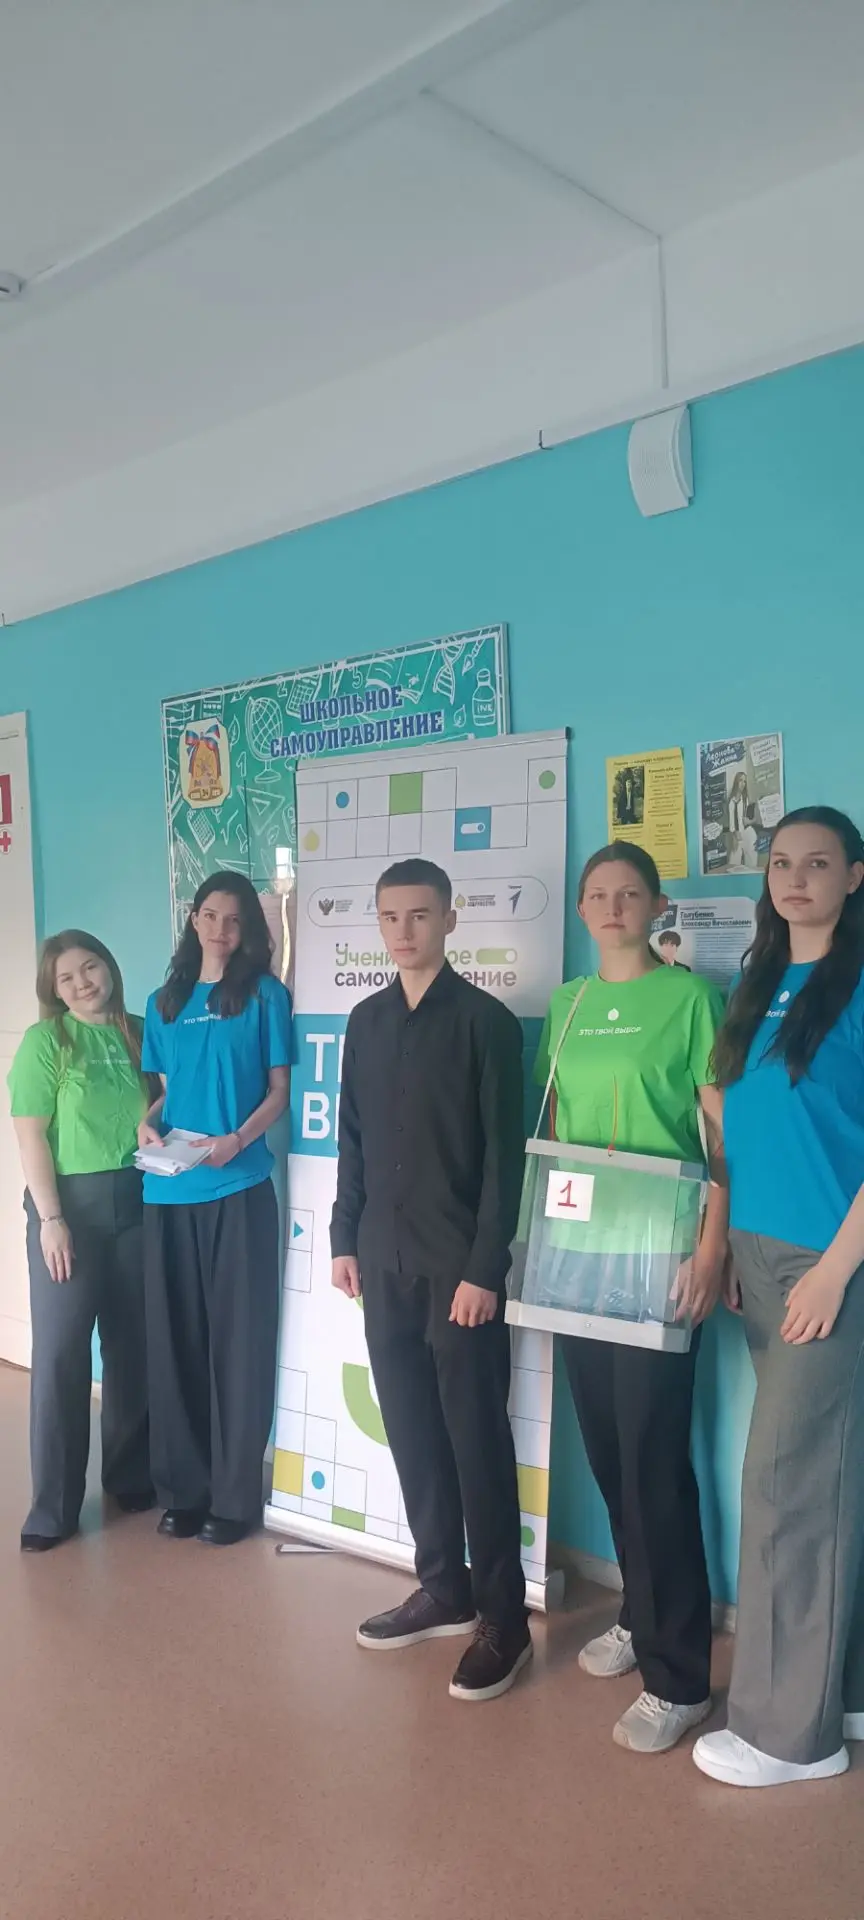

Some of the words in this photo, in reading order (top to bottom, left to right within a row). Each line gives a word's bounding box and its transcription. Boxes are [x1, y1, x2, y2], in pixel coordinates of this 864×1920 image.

[300, 684, 404, 725] ШКОЛЬНОЕ
[269, 710, 444, 758] САМОУПРАВЛЕНИЕ
[558, 1180, 577, 1208] 1
